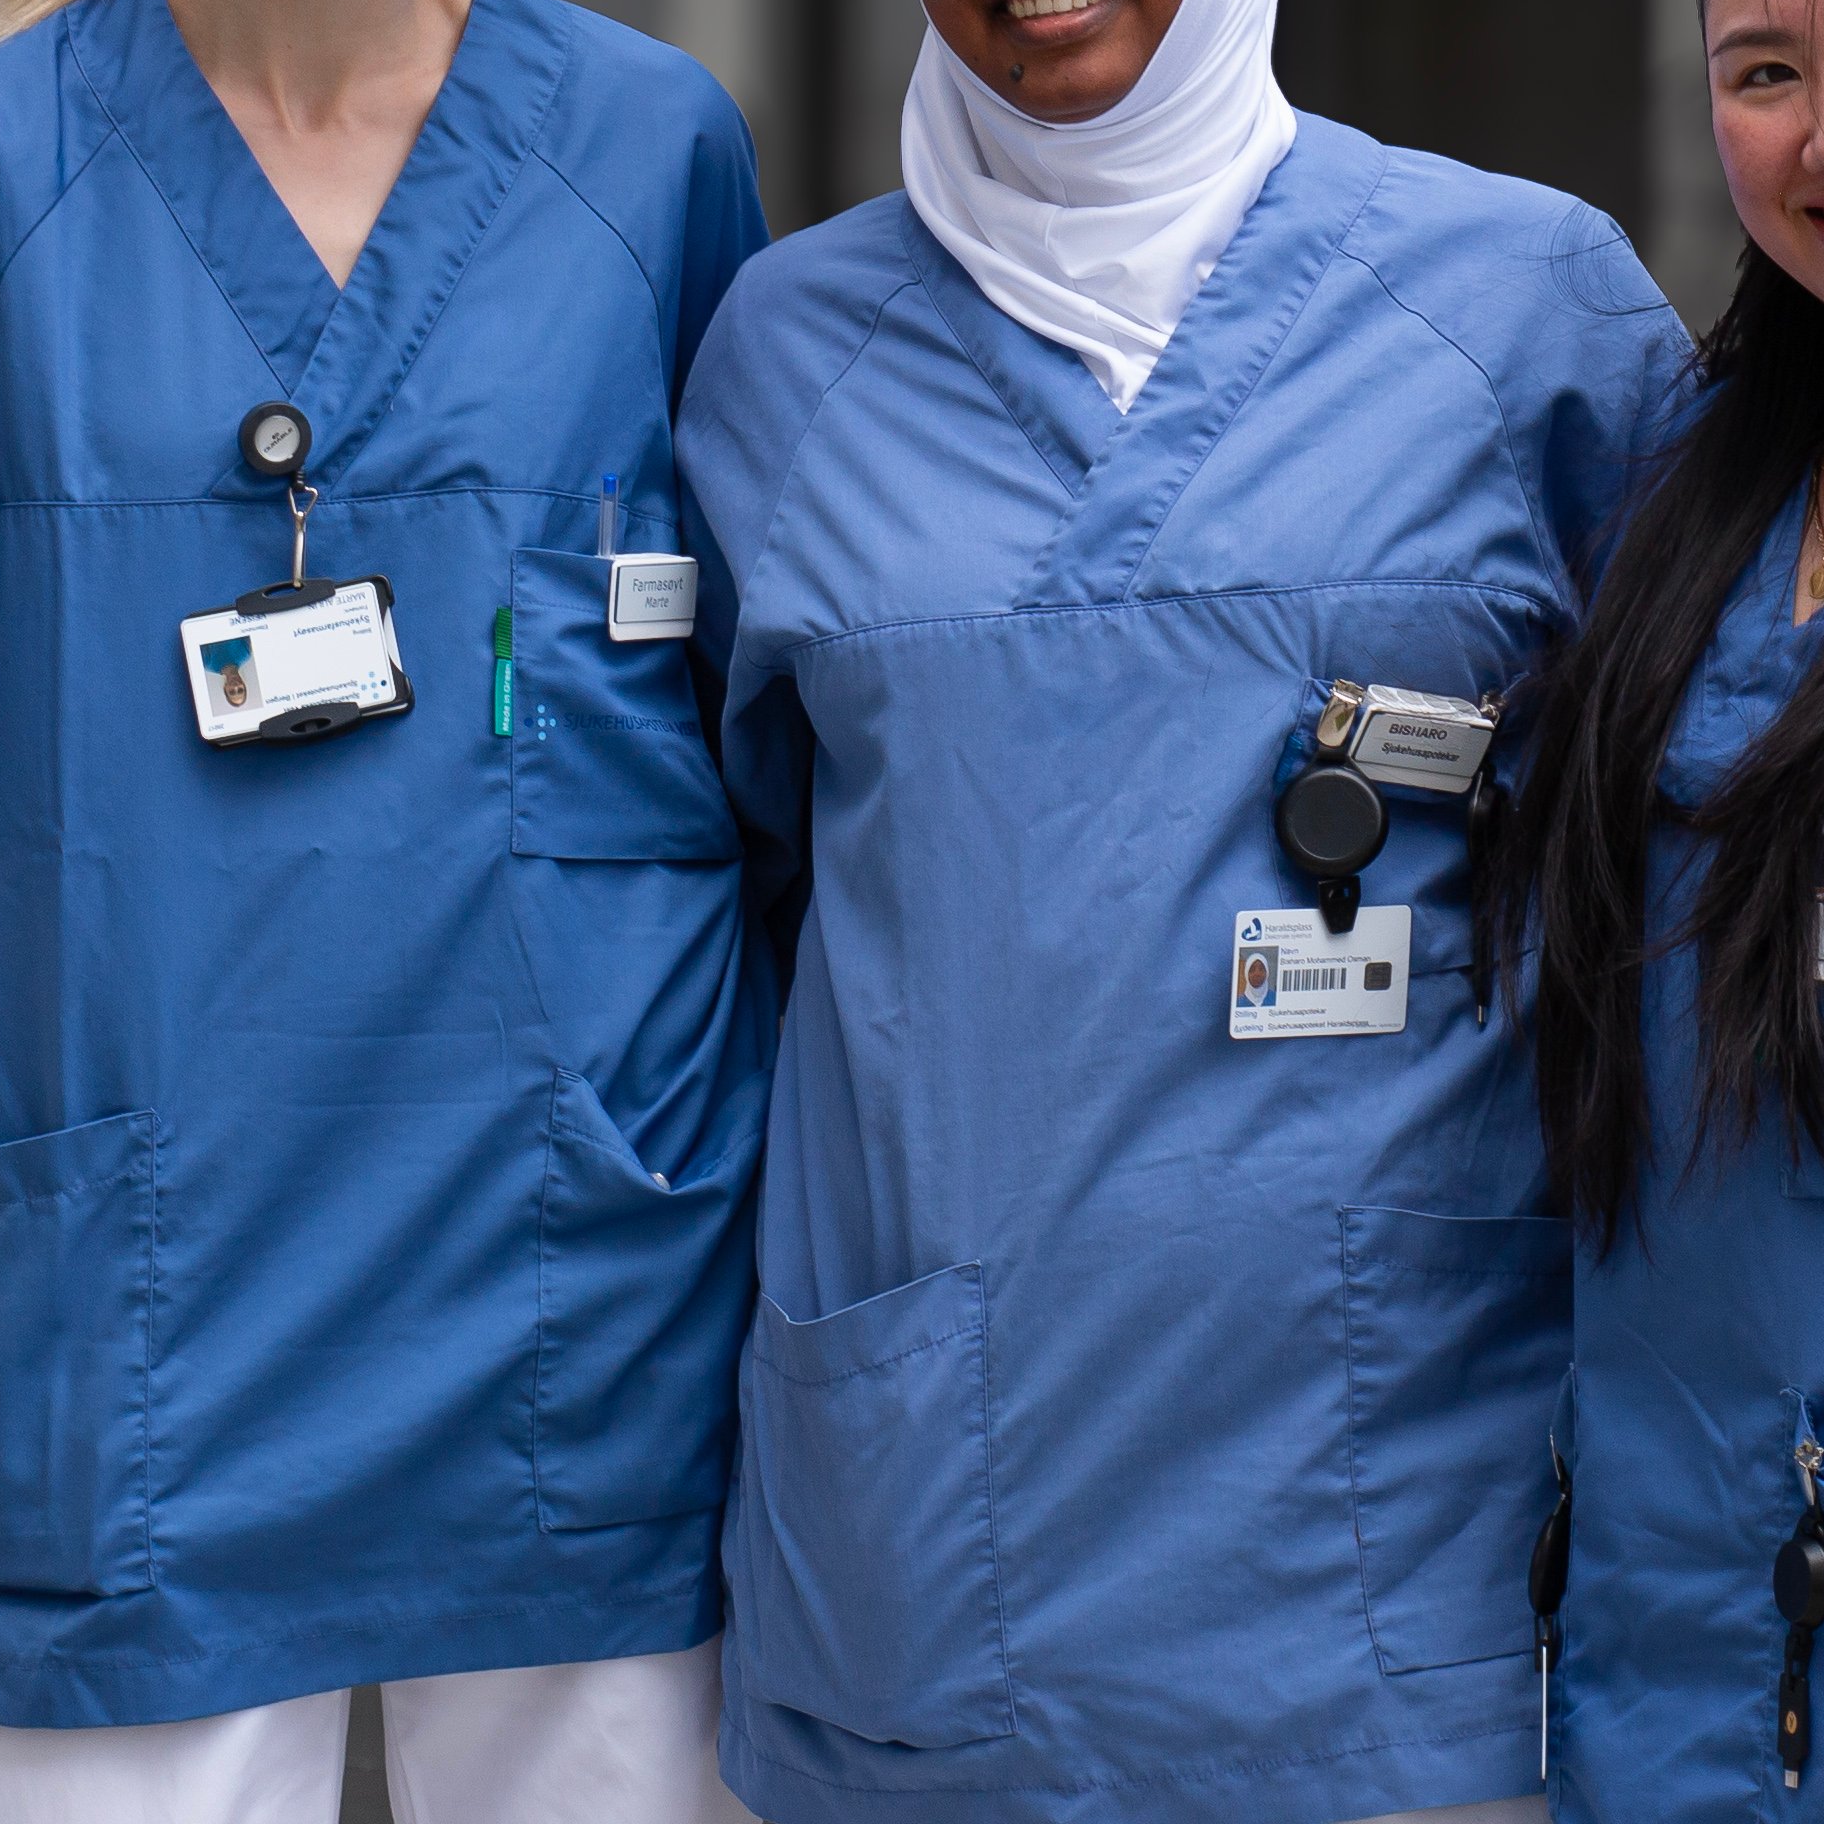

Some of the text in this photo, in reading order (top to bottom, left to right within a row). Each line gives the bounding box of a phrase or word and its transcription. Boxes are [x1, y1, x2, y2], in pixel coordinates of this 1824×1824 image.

[632, 578, 684, 594] Farmasøyt
[645, 596, 670, 608] Marte
[504, 694, 511, 703] in
[503, 706, 511, 731] Made
[1388, 723, 1448, 740] BISHARO
[1381, 742, 1459, 762] Sjukehusapotekar
